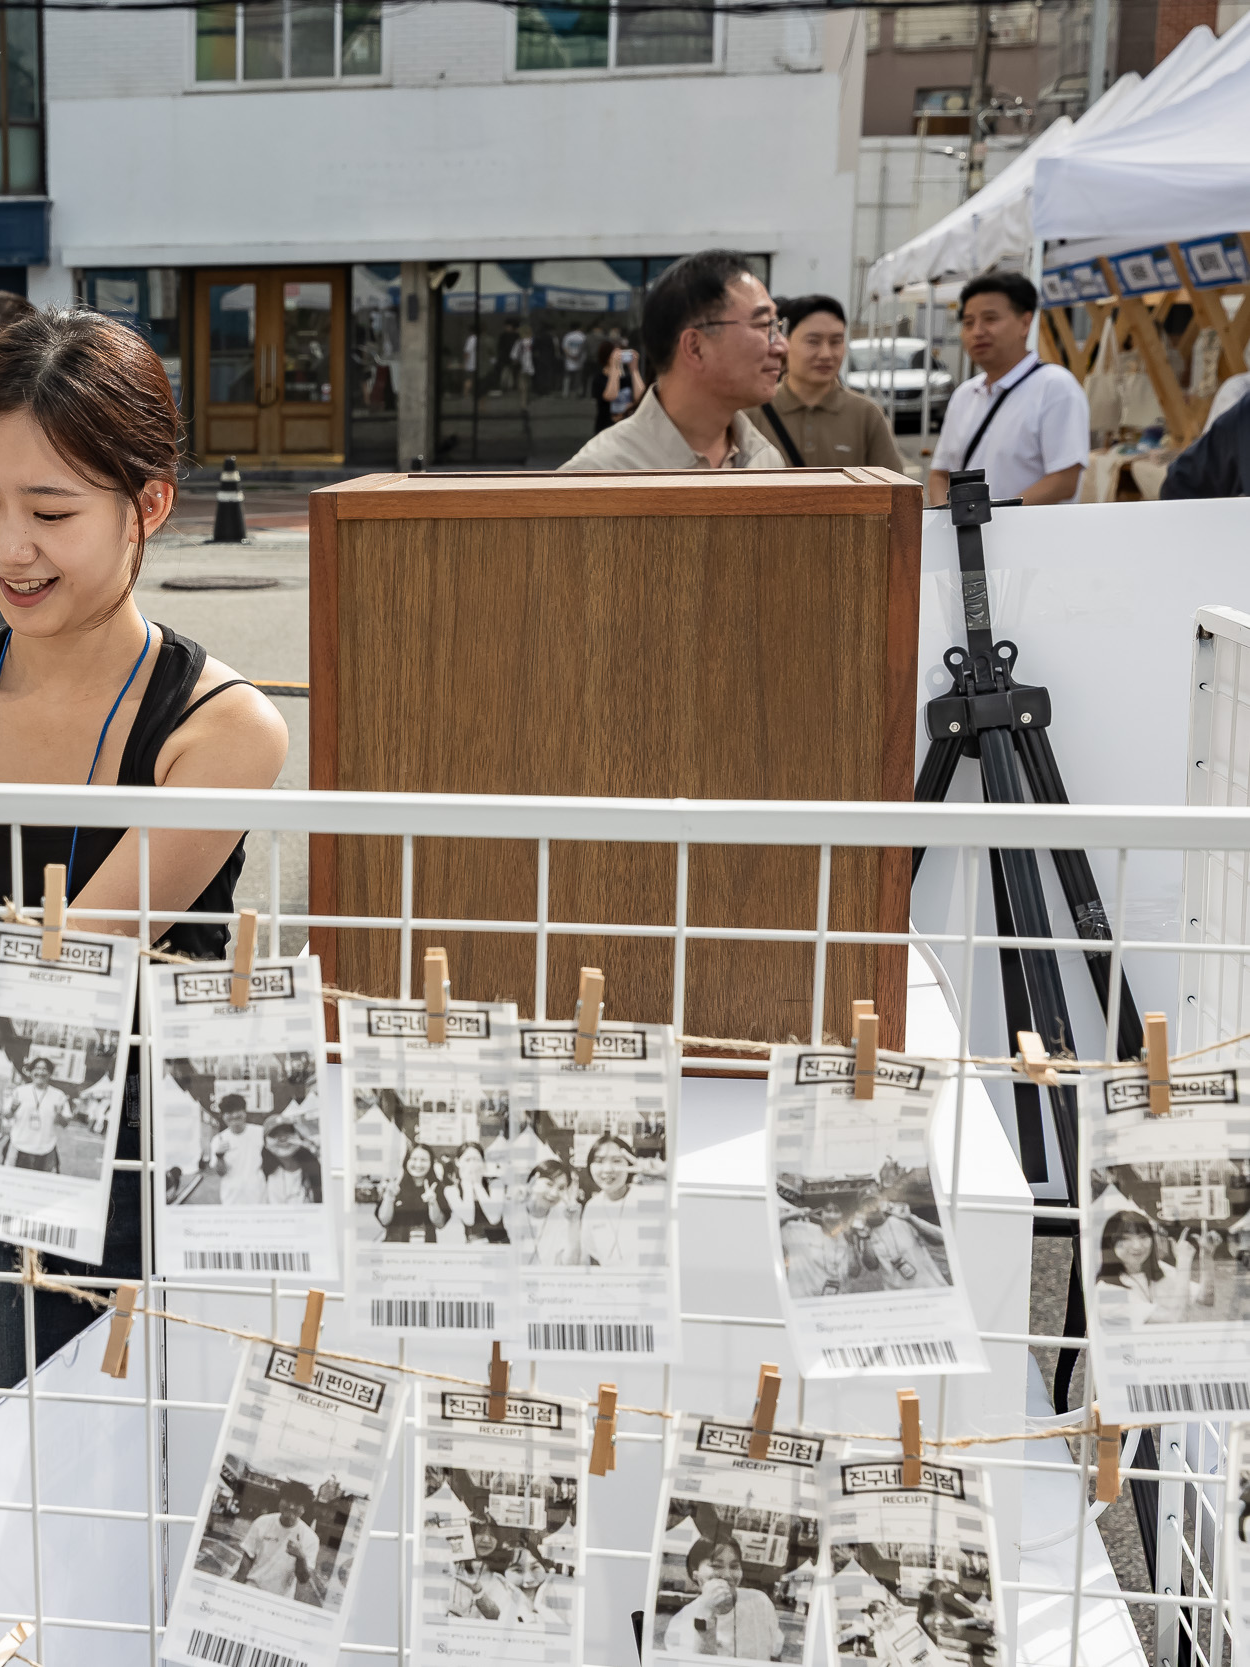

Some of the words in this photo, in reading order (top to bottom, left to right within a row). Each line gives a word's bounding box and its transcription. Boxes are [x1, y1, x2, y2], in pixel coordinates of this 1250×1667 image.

[29, 971, 73, 984] RECEIPT
[182, 977, 232, 997] 진구네
[250, 975, 285, 993] 의점
[376, 1016, 427, 1032] 진구네
[446, 1016, 481, 1033] 의점
[805, 1060, 855, 1077] 진구네
[877, 1067, 914, 1084] 의점
[1112, 1085, 1150, 1104] 진구
[275, 1358, 324, 1387] 진네
[326, 1374, 374, 1403] 편의점
[297, 1393, 341, 1412] RECEIPT
[479, 1426, 524, 1437] RECEIPT
[732, 1458, 779, 1473] RECEIPT
[849, 1468, 902, 1487] 진구네
[919, 1470, 954, 1490] 의점
[882, 1495, 930, 1504] RECEIPT
[436, 1642, 481, 1657] Signature
